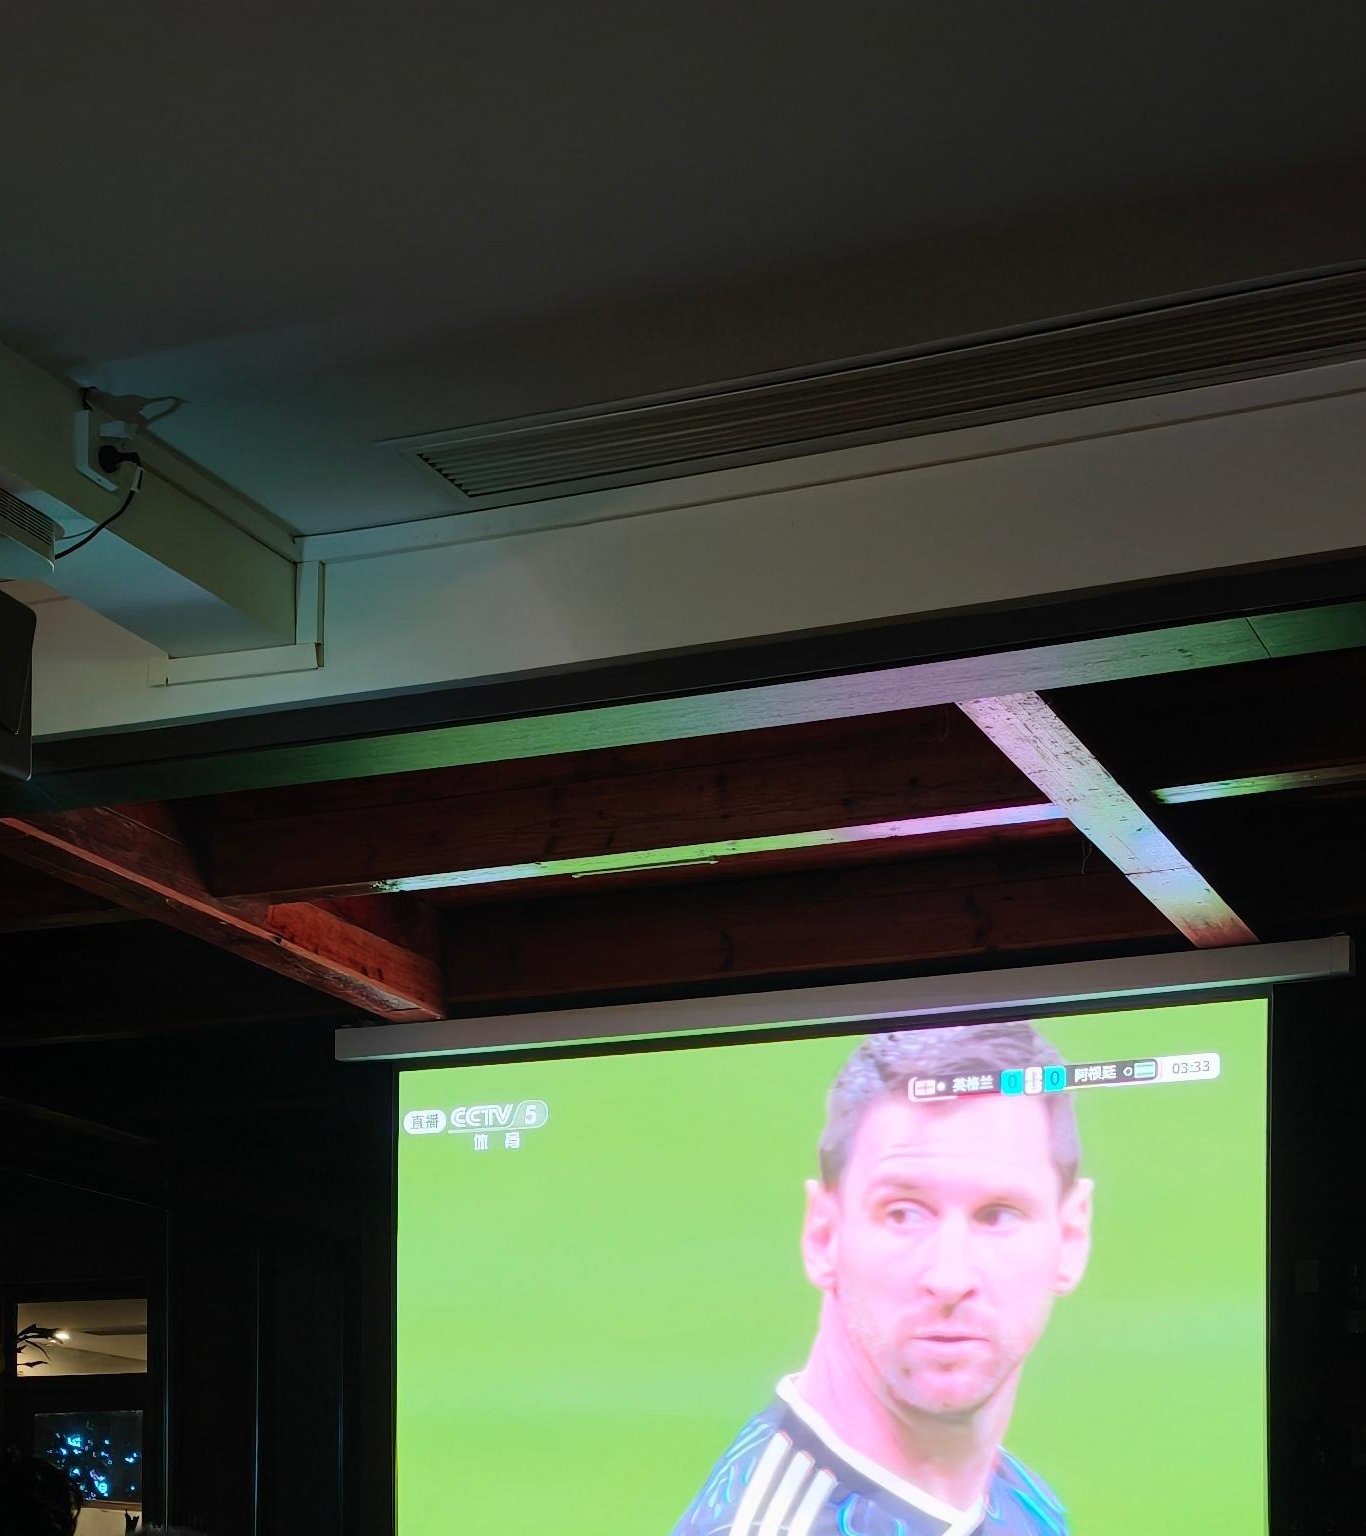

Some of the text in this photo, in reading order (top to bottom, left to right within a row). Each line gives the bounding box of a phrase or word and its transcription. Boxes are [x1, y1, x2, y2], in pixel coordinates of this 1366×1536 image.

[952, 1074, 994, 1093] 英格兰
[1074, 1064, 1117, 1083] 阿根廷
[1172, 1060, 1211, 1075] 03:33
[410, 1113, 439, 1130] 直播
[450, 1103, 513, 1128] CCTV
[473, 1131, 520, 1151] 体育
